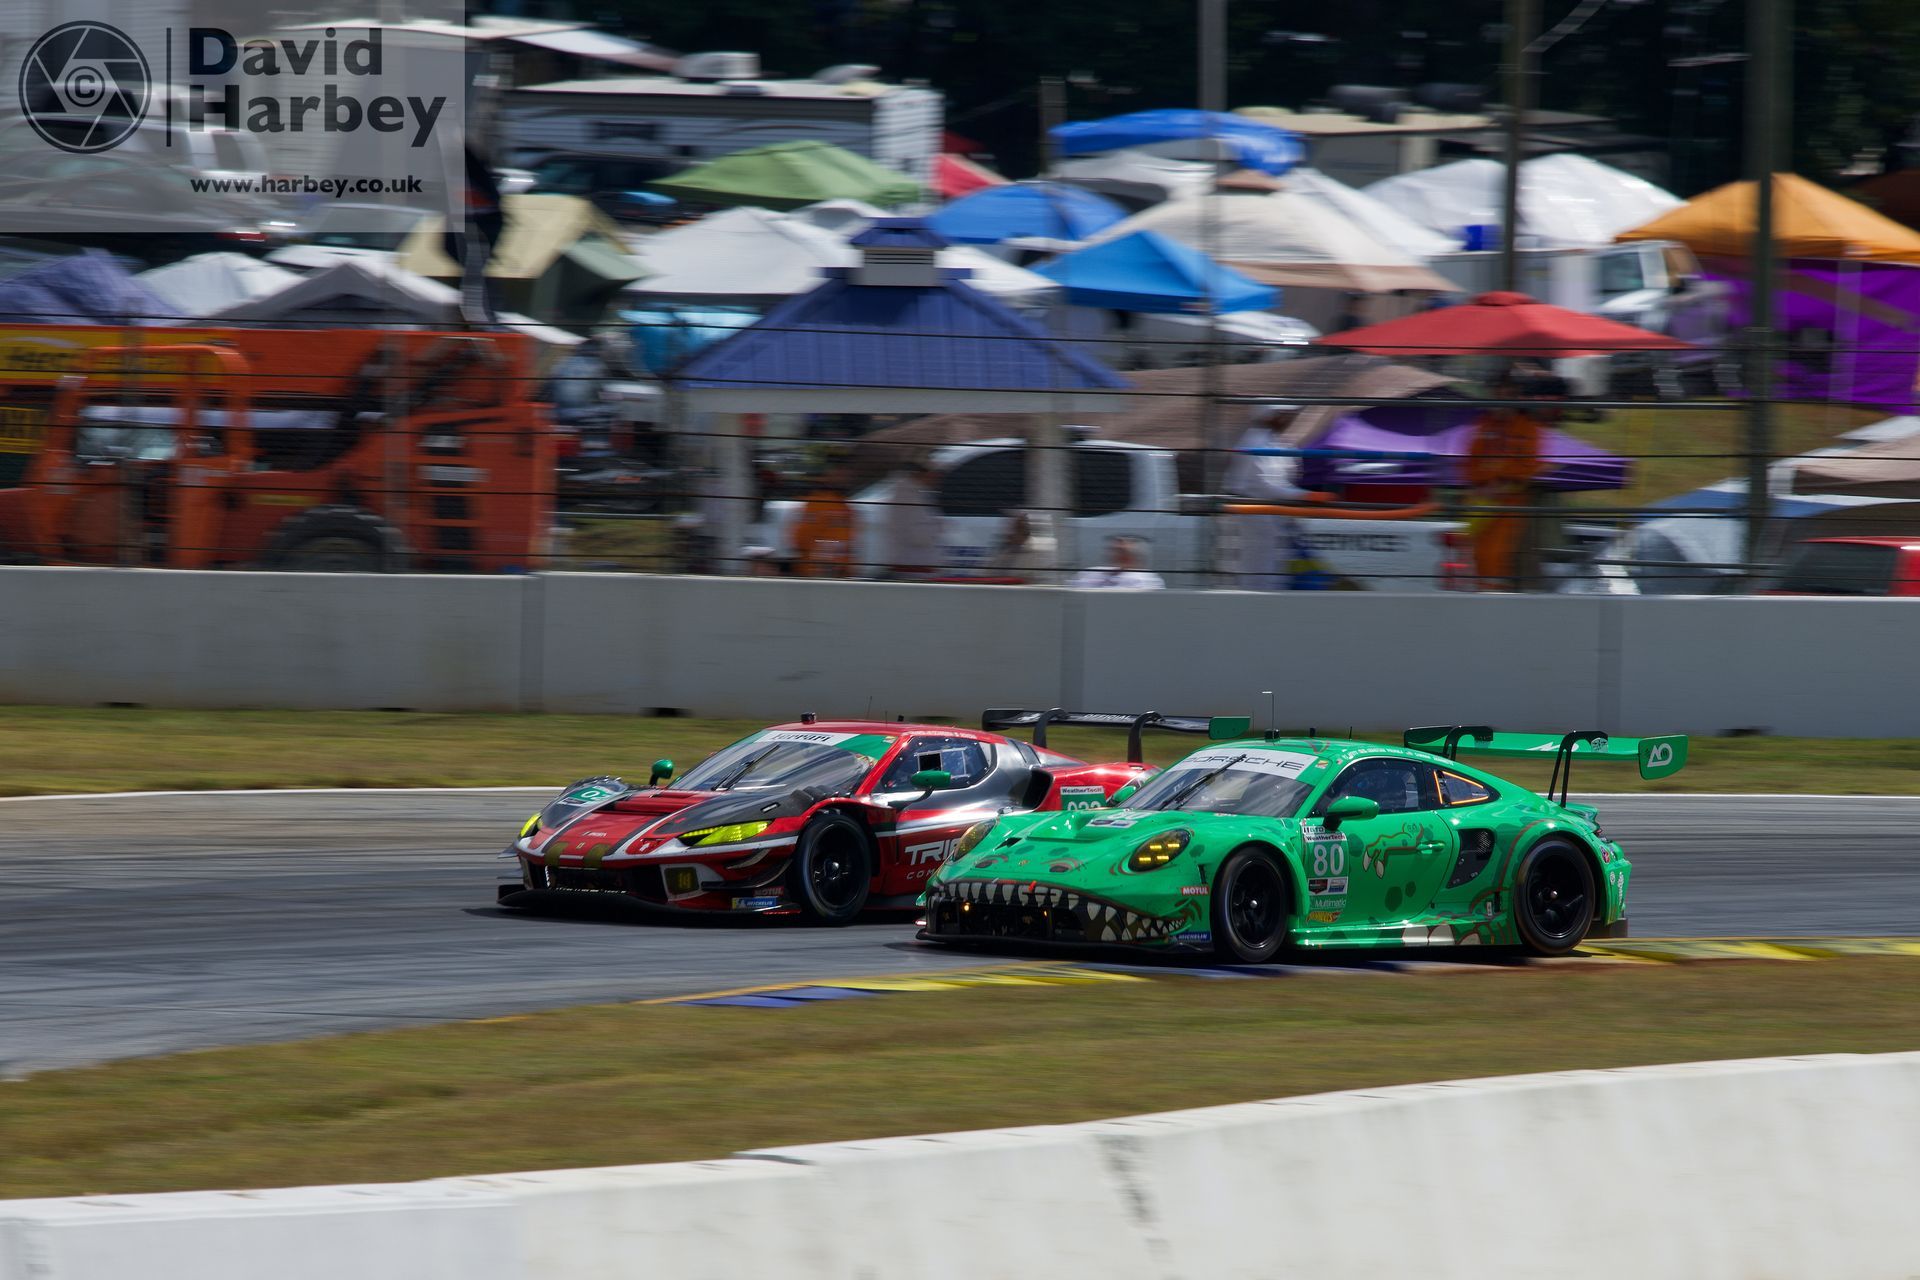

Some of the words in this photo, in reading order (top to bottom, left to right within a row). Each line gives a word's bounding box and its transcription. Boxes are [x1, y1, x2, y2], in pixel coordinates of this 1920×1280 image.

[1305, 832, 1346, 841] WeatherTech
[1313, 843, 1345, 876] 80
[1183, 886, 1209, 895] MOTUL
